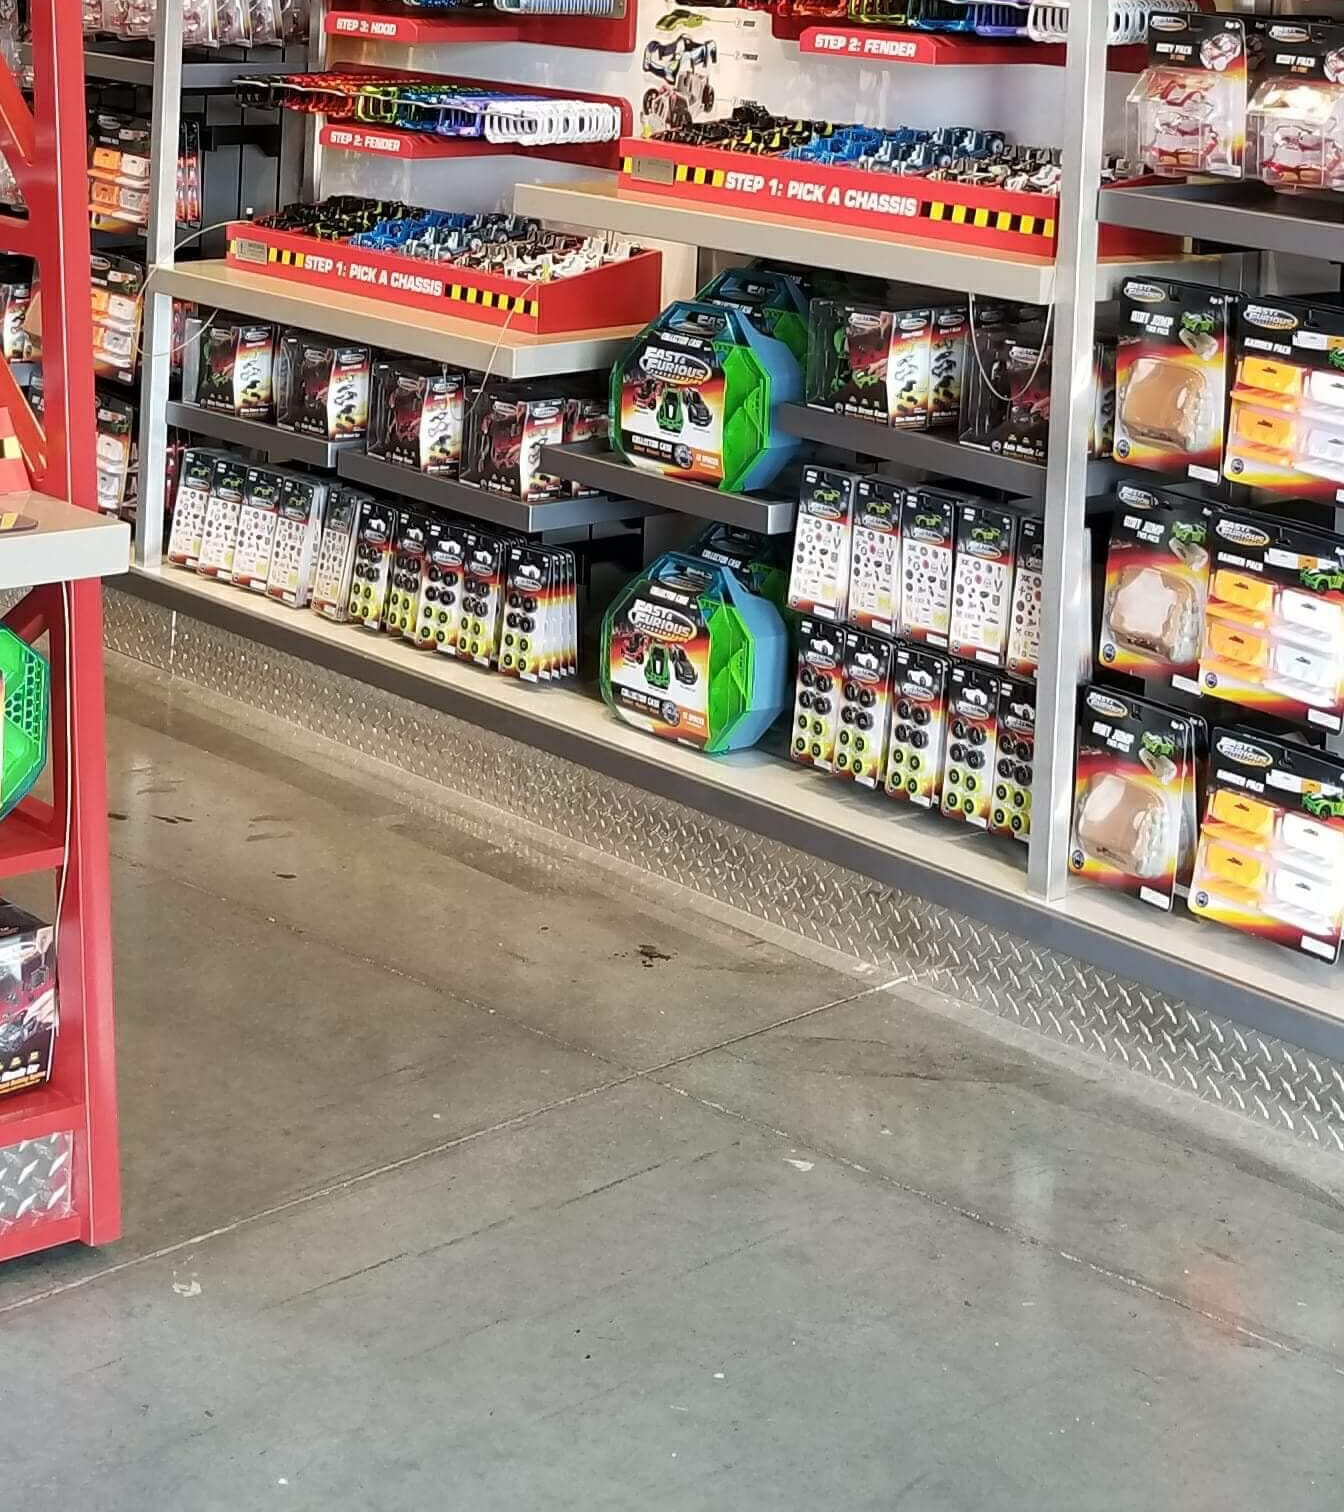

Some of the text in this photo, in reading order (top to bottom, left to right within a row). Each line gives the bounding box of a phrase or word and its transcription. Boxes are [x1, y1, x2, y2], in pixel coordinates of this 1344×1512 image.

[336, 18, 357, 31] STEP
[372, 22, 396, 36] HOOD
[815, 35, 916, 57] STEP 2: FENDER
[329, 130, 350, 145] STEP
[364, 136, 401, 152] FENDER
[725, 172, 917, 216] STEP 1: PICK A CHASSIS
[304, 255, 442, 296] STEP 1: PICK A CHASSIS
